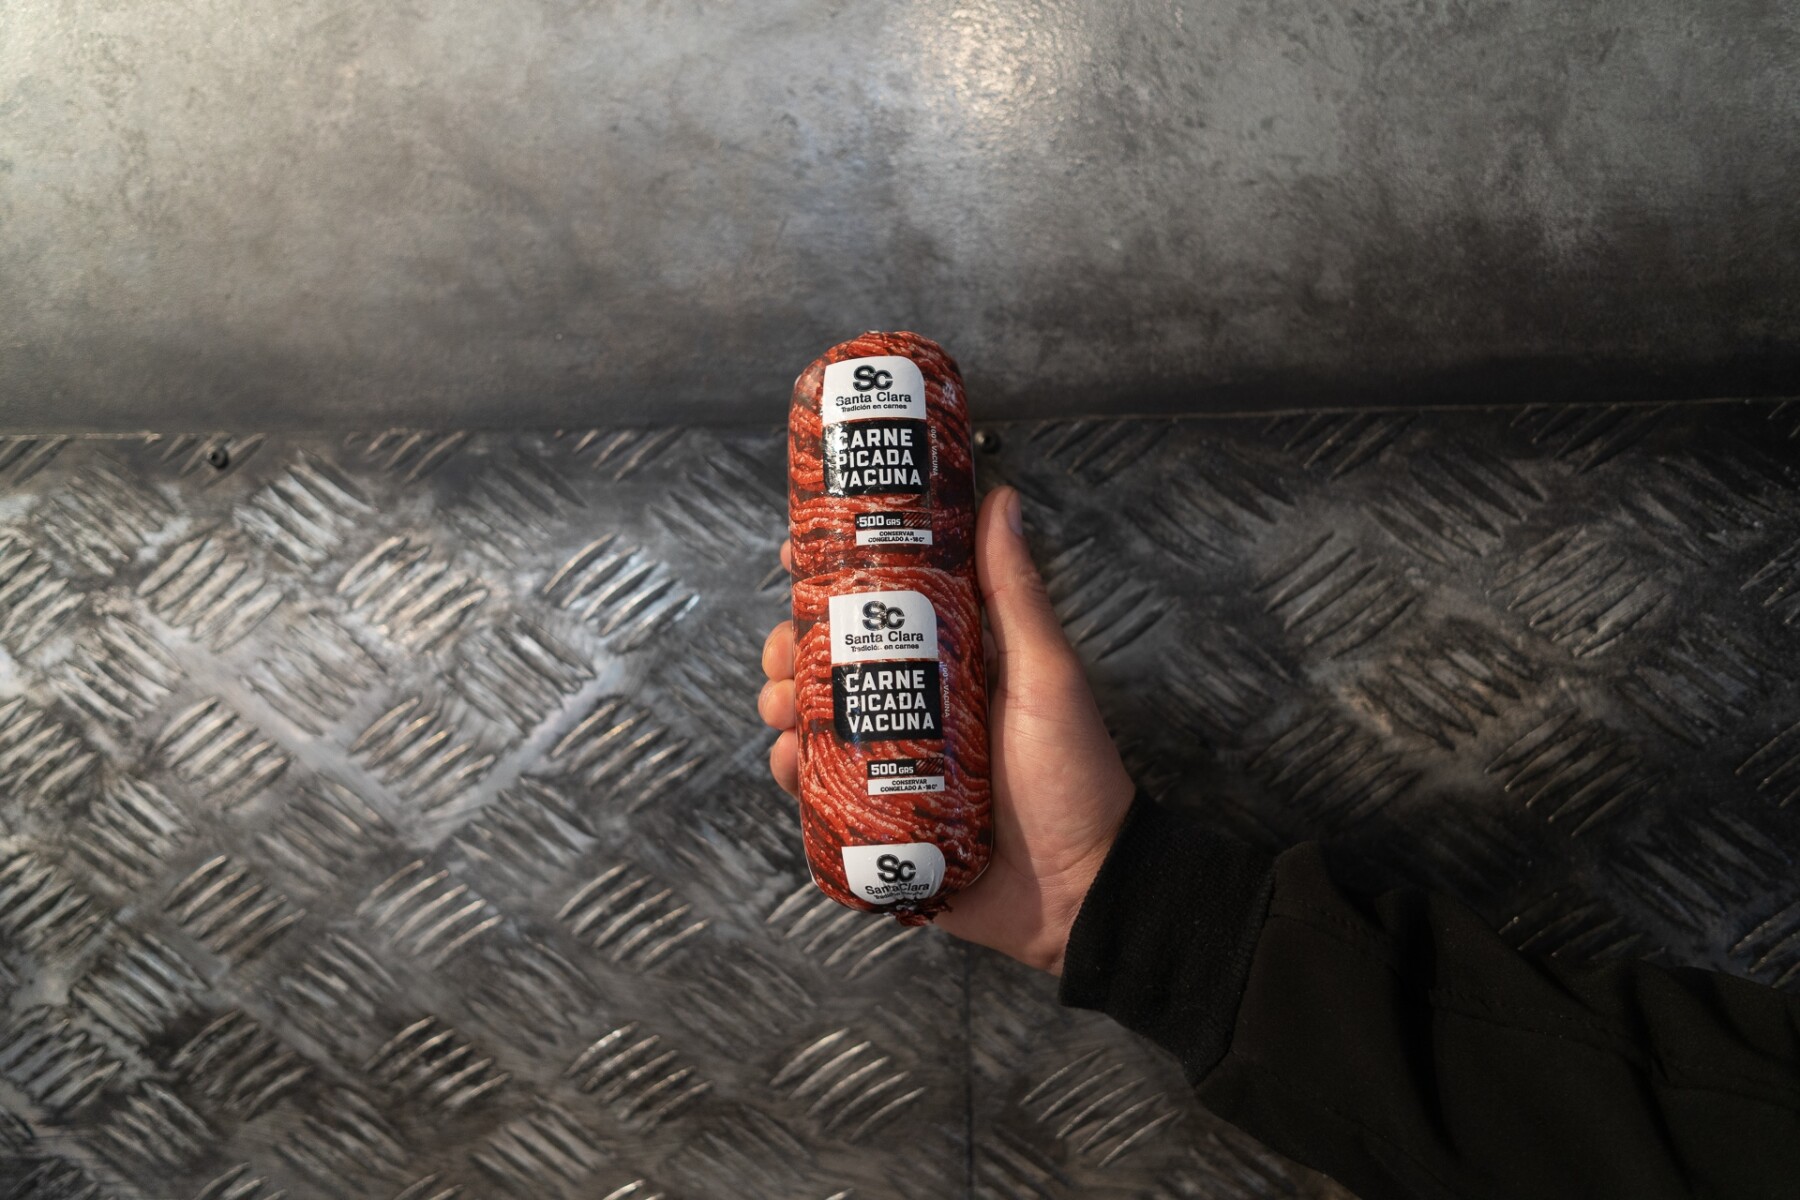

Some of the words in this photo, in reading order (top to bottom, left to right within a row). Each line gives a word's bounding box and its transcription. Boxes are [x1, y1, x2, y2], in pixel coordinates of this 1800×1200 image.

[836, 393, 872, 407] Santa
[876, 391, 912, 403] Clara
[841, 404, 871, 412] Tradición
[836, 428, 913, 449] CARNE
[836, 449, 914, 469] PICADA
[931, 445, 939, 477] VACUNA
[837, 468, 922, 489] VACUNA
[859, 515, 884, 527] 500
[886, 518, 901, 526] GRS
[845, 632, 883, 645] Santa
[888, 630, 924, 642] Clara
[845, 670, 926, 692] CARNE
[846, 692, 926, 713] PICADA
[847, 712, 934, 733] VACUNA
[870, 763, 897, 775] 500
[898, 766, 914, 774] GRS
[900, 883, 930, 892] Clara
